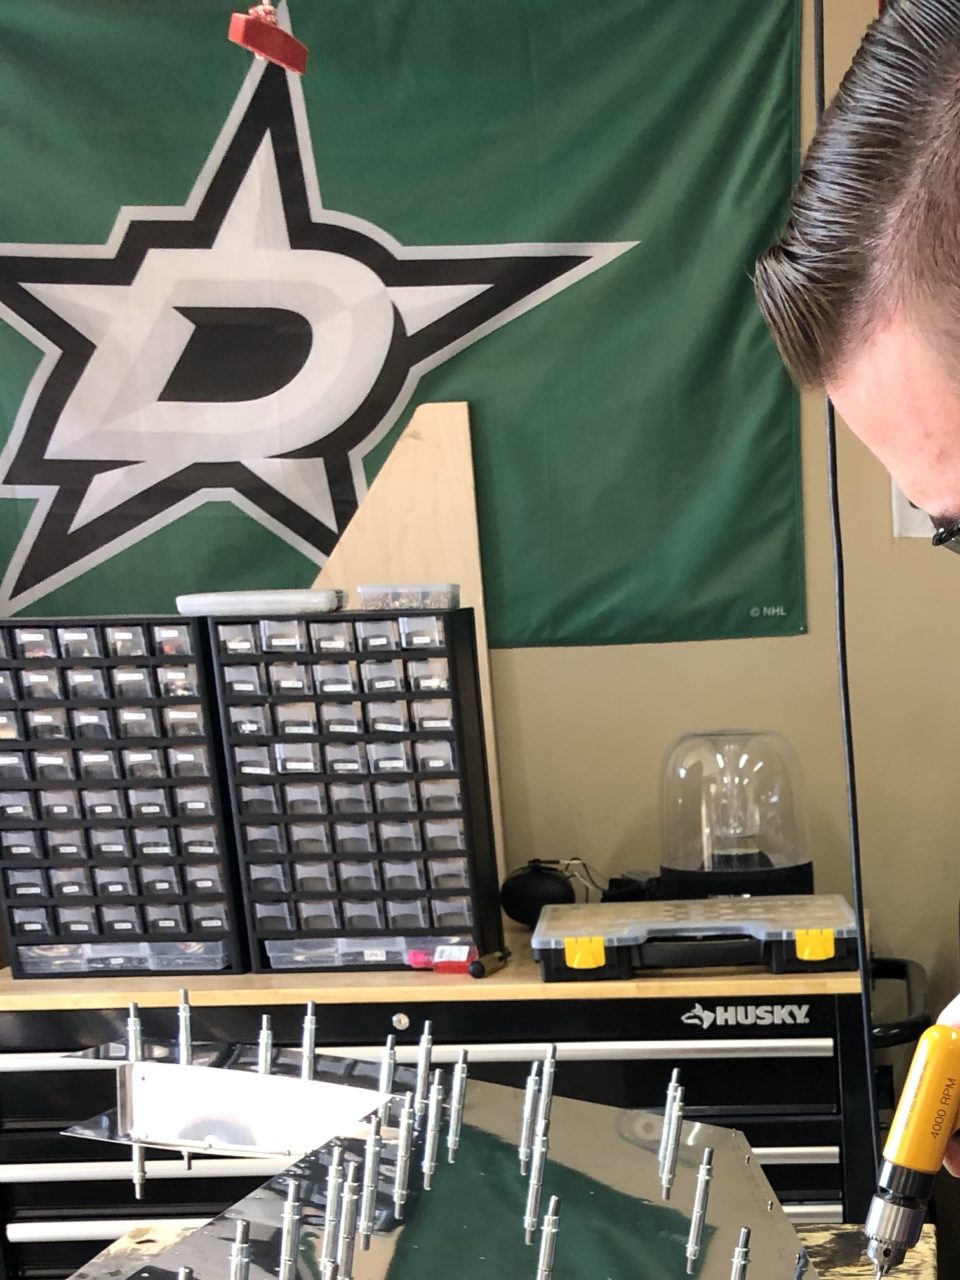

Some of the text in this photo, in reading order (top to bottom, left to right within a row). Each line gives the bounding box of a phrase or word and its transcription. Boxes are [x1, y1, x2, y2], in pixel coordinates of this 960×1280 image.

[763, 606, 787, 617] NHL
[716, 1004, 810, 1025] HUSKY
[930, 1077, 957, 1139] 4000 RPM
